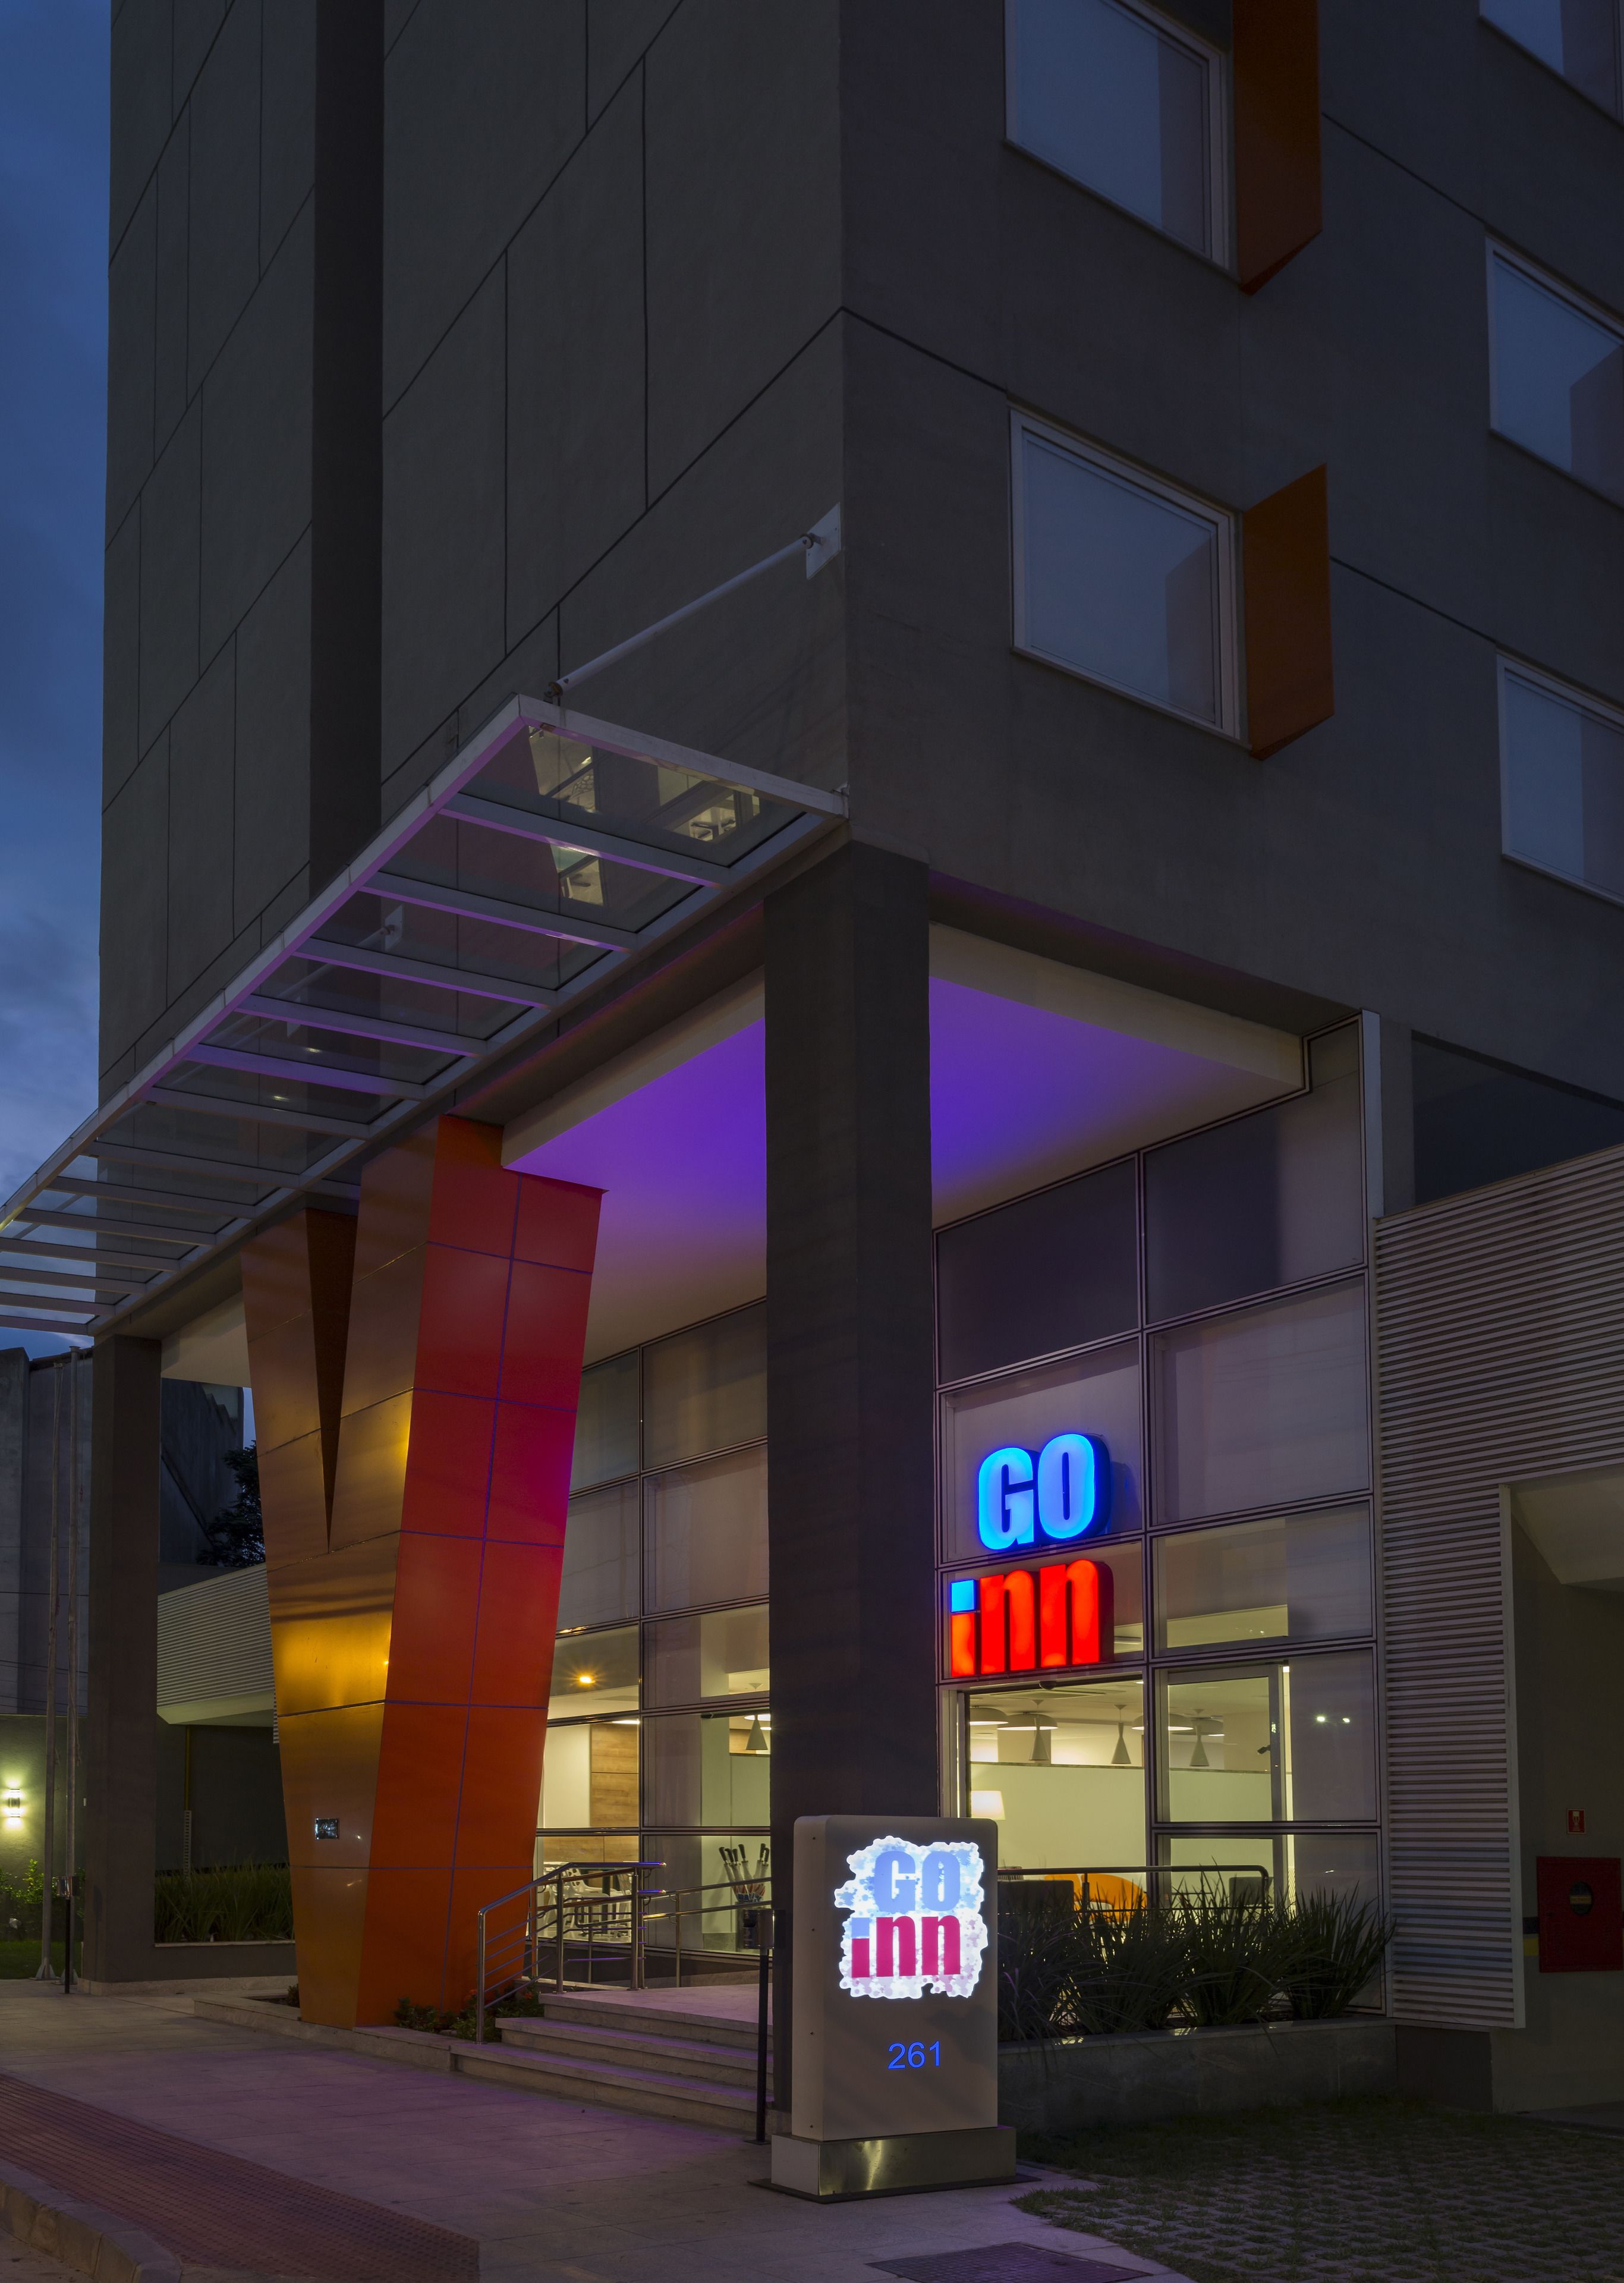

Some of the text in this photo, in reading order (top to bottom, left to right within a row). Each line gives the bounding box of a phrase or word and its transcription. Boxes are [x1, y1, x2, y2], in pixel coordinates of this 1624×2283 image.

[978, 1433, 1096, 1550] GO
[951, 1559, 1100, 1677] inn
[874, 1850, 961, 1913] GO
[851, 1915, 961, 1978] inn
[888, 2040, 940, 2069] 261
